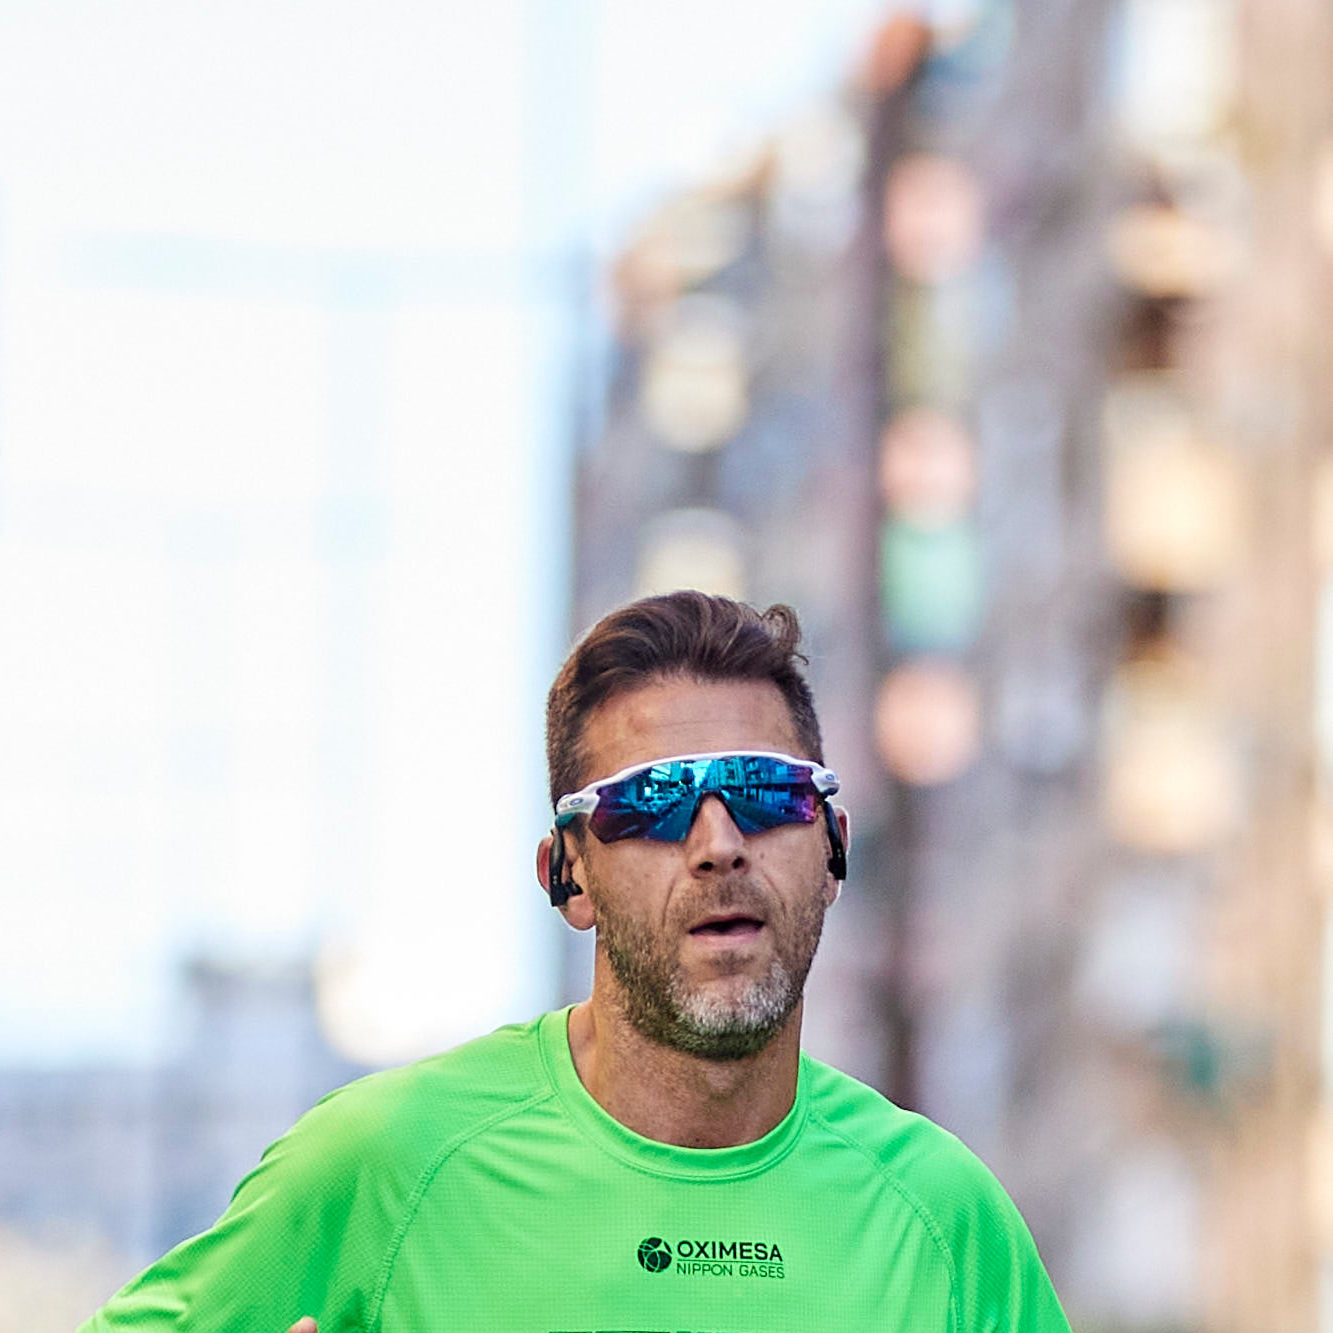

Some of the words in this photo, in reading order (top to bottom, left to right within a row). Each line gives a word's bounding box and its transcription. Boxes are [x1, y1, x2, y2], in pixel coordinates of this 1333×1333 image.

[676, 1240, 783, 1262] OXIMESA
[676, 1263, 733, 1277] NIPPON
[739, 1265, 786, 1279] GASES
